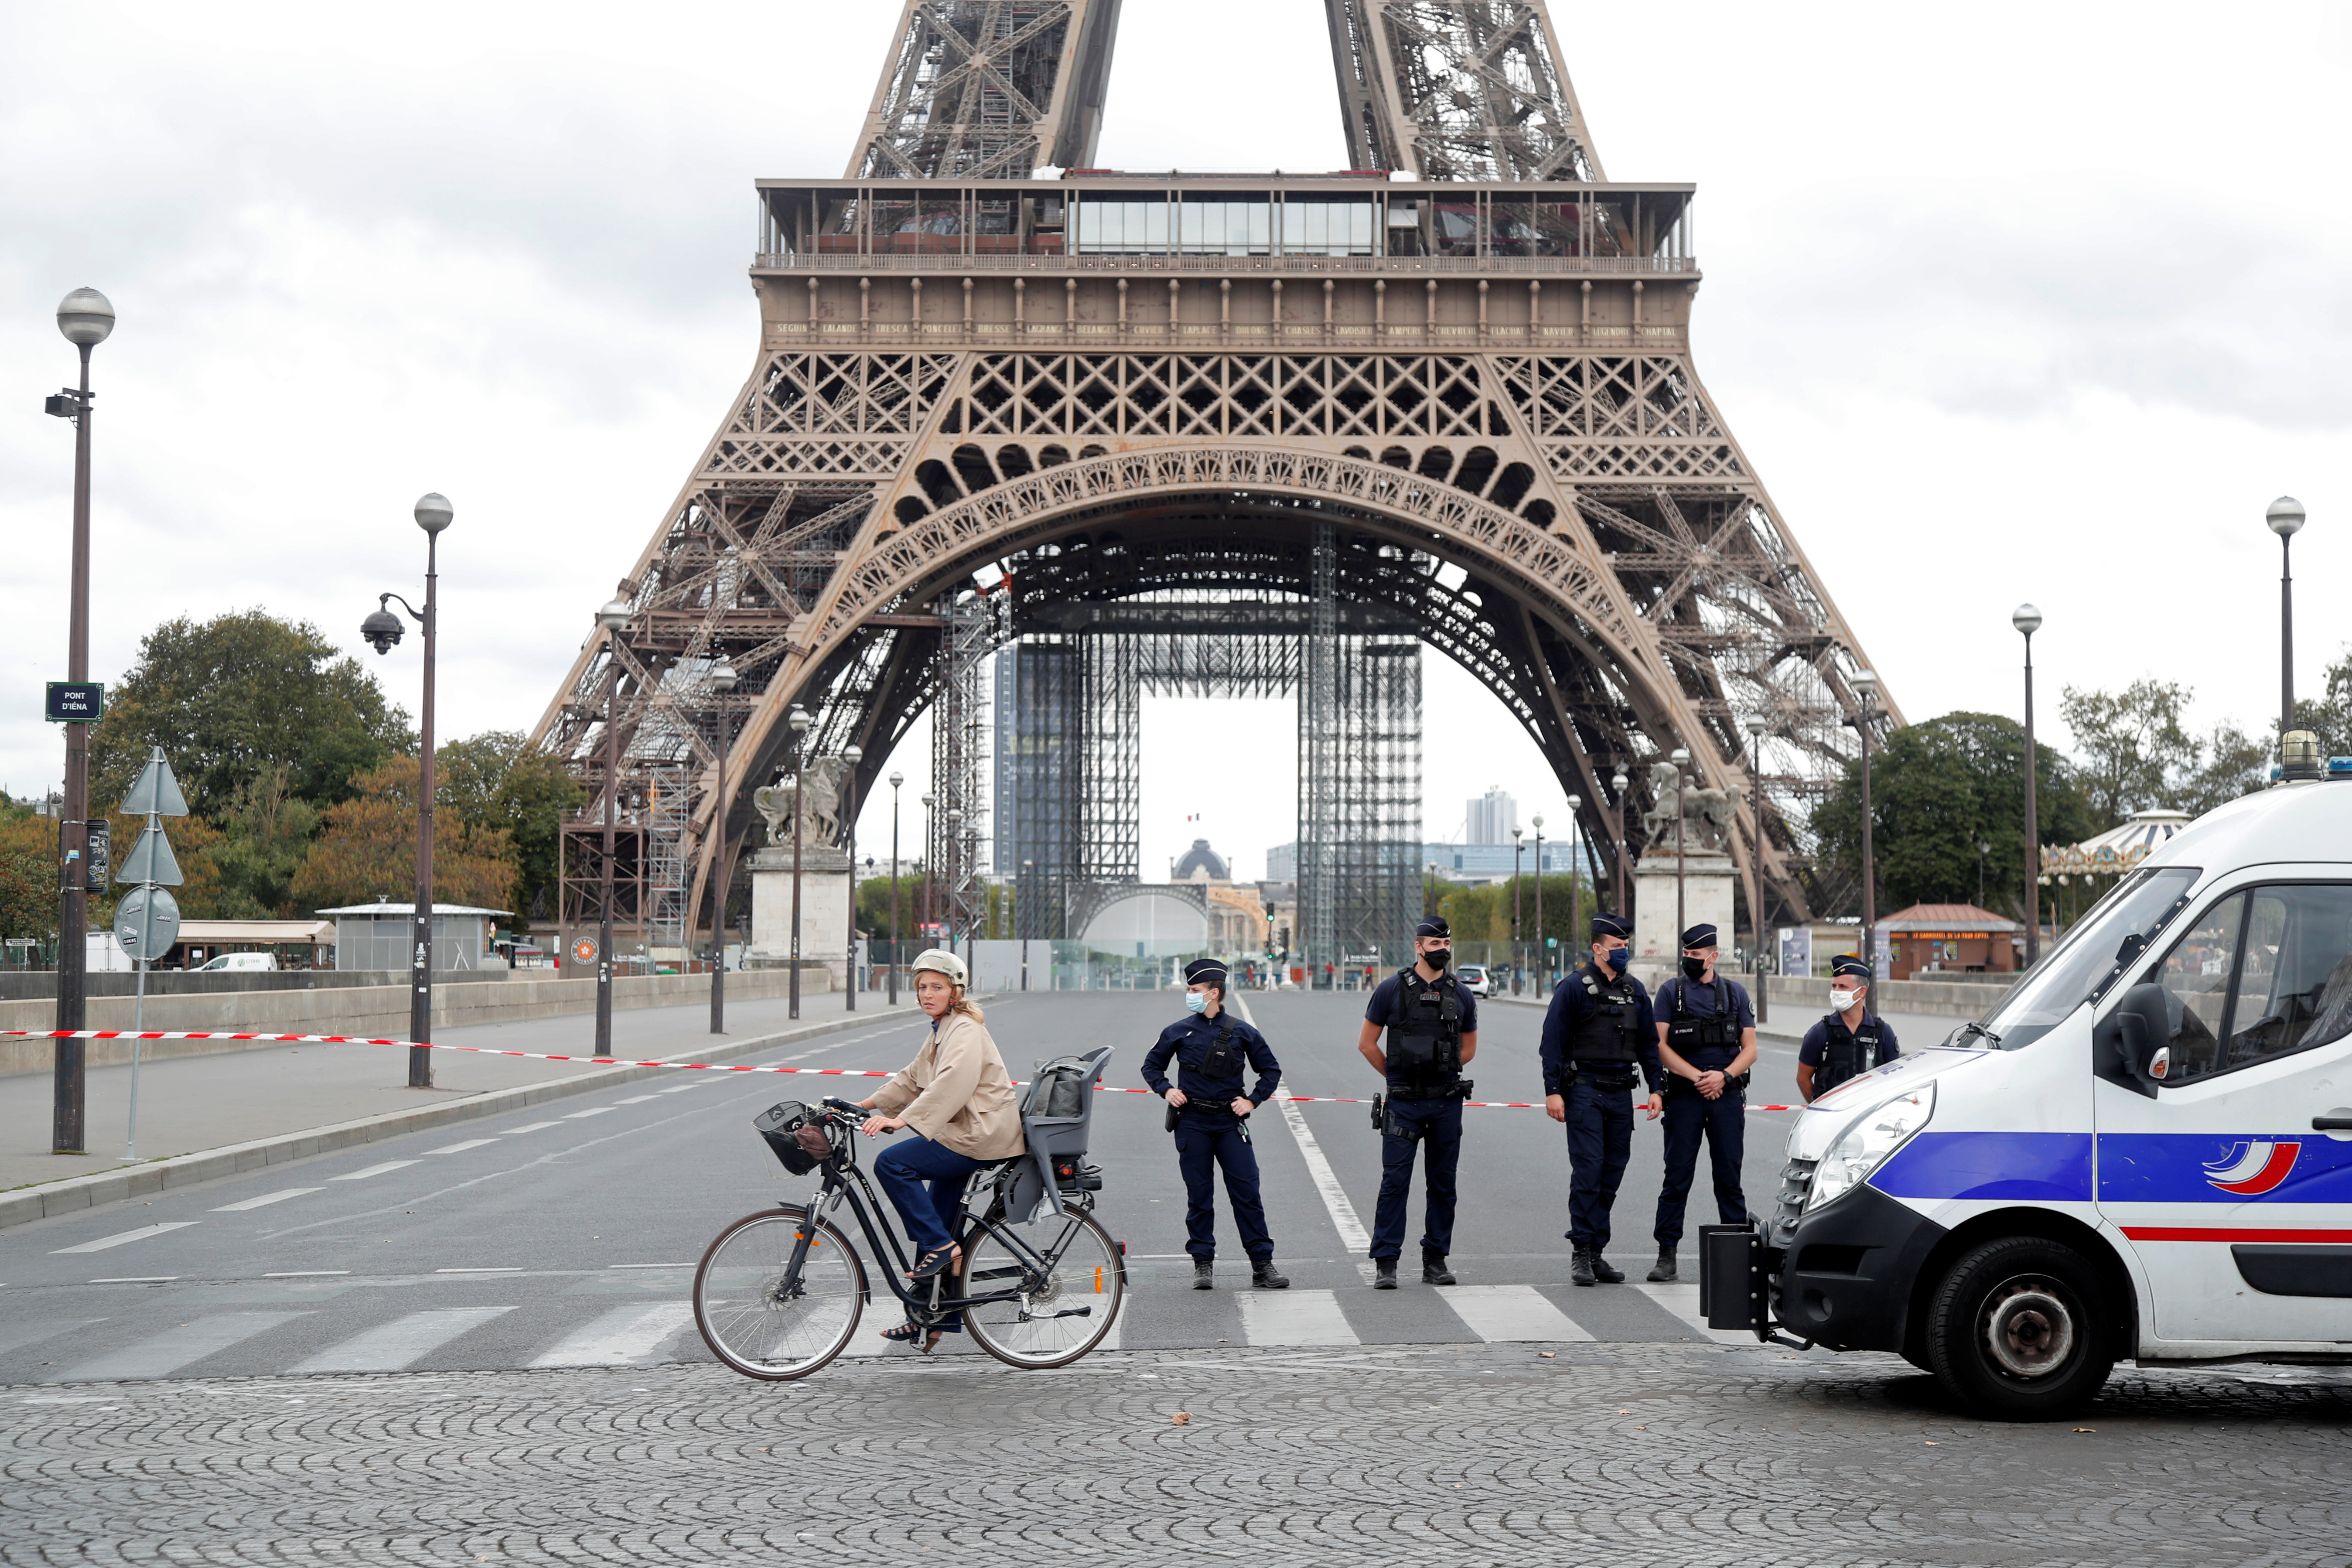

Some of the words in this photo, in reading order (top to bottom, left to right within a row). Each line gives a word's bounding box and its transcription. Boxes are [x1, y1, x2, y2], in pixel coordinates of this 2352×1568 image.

[777, 324, 807, 332] SEGUIN
[823, 324, 857, 333] LALANDE
[876, 324, 908, 332] TRESCA
[921, 324, 963, 333] PONCELET
[977, 324, 1010, 332] BRESSE
[1027, 325, 1065, 333] LAGRANGE
[1076, 325, 1117, 333] BELANGER
[1134, 325, 1164, 334] CUVIER
[1235, 326, 1267, 334] DULONG
[1285, 326, 1321, 335] CHASLES
[1335, 326, 1373, 335] LAVOISIER
[1436, 327, 1476, 335] CHEVREUL
[1491, 327, 1524, 335] FLACHAT
[1543, 327, 1574, 336] NAVIER
[1593, 327, 1631, 336] LEGENDRE
[1642, 327, 1676, 336] CHAPTAL
[62, 701, 88, 711] D'IÉNA
